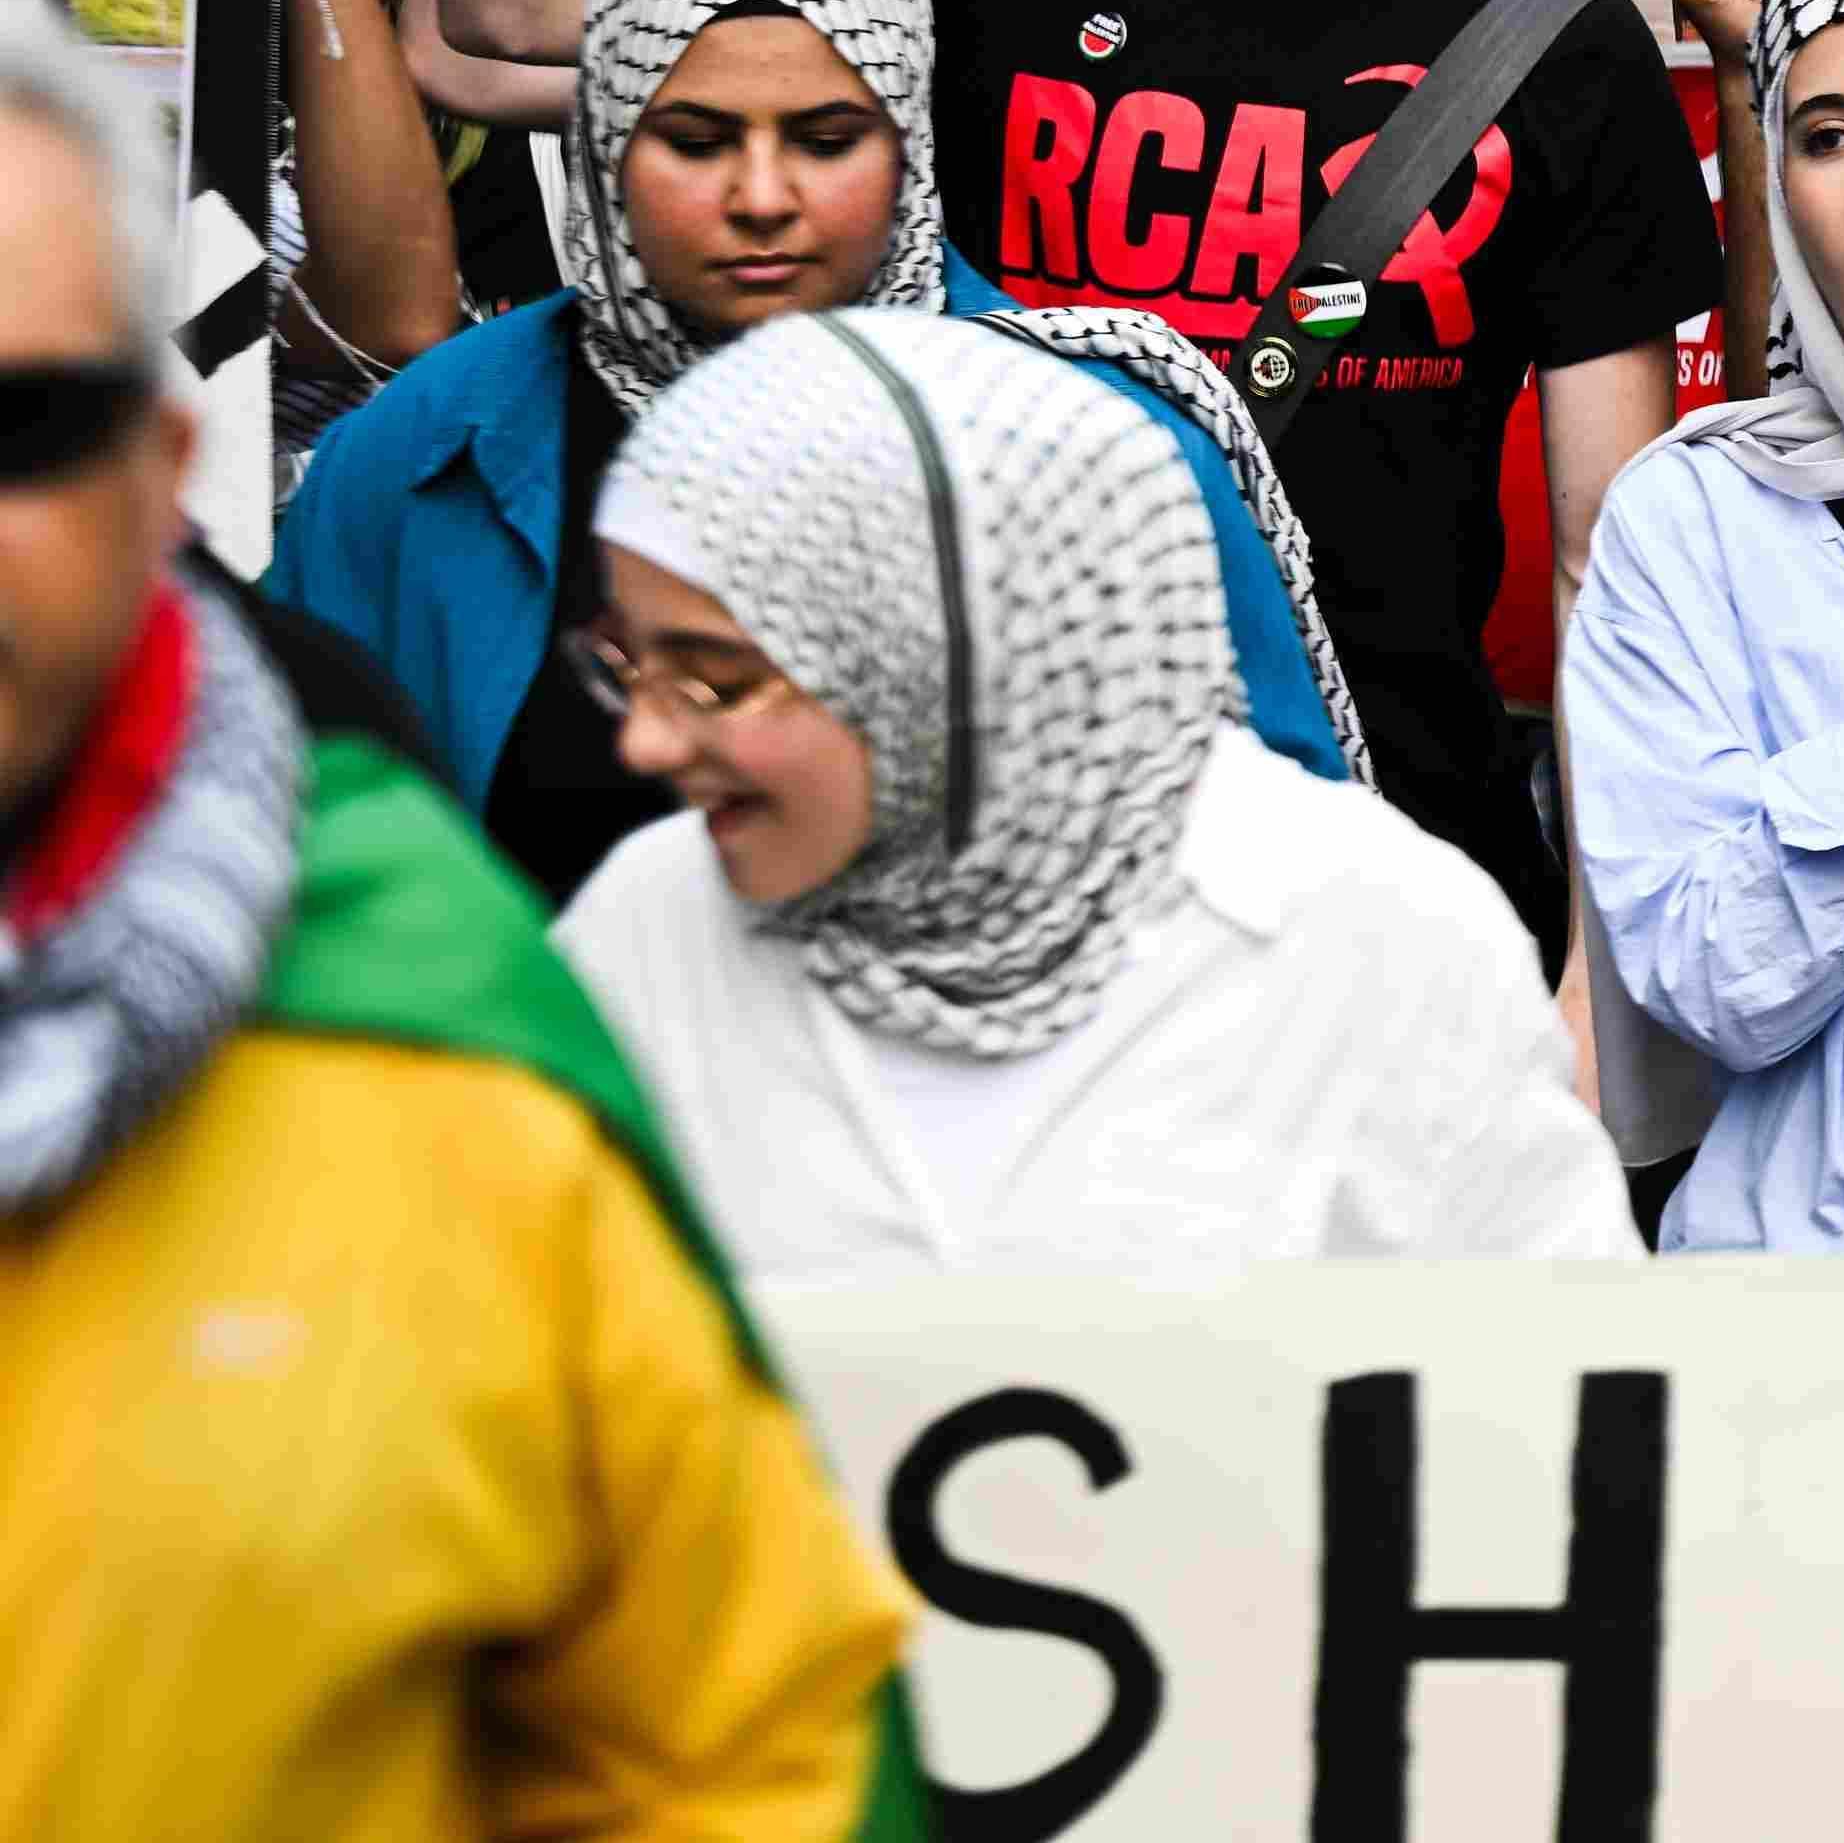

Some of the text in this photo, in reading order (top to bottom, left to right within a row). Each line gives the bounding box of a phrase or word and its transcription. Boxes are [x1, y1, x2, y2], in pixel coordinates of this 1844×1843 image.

[1002, 71, 1306, 298] RCA
[1316, 292, 1362, 308] PALESTINE
[1336, 356, 1368, 389] OF
[1375, 357, 1466, 390] AMERICA
